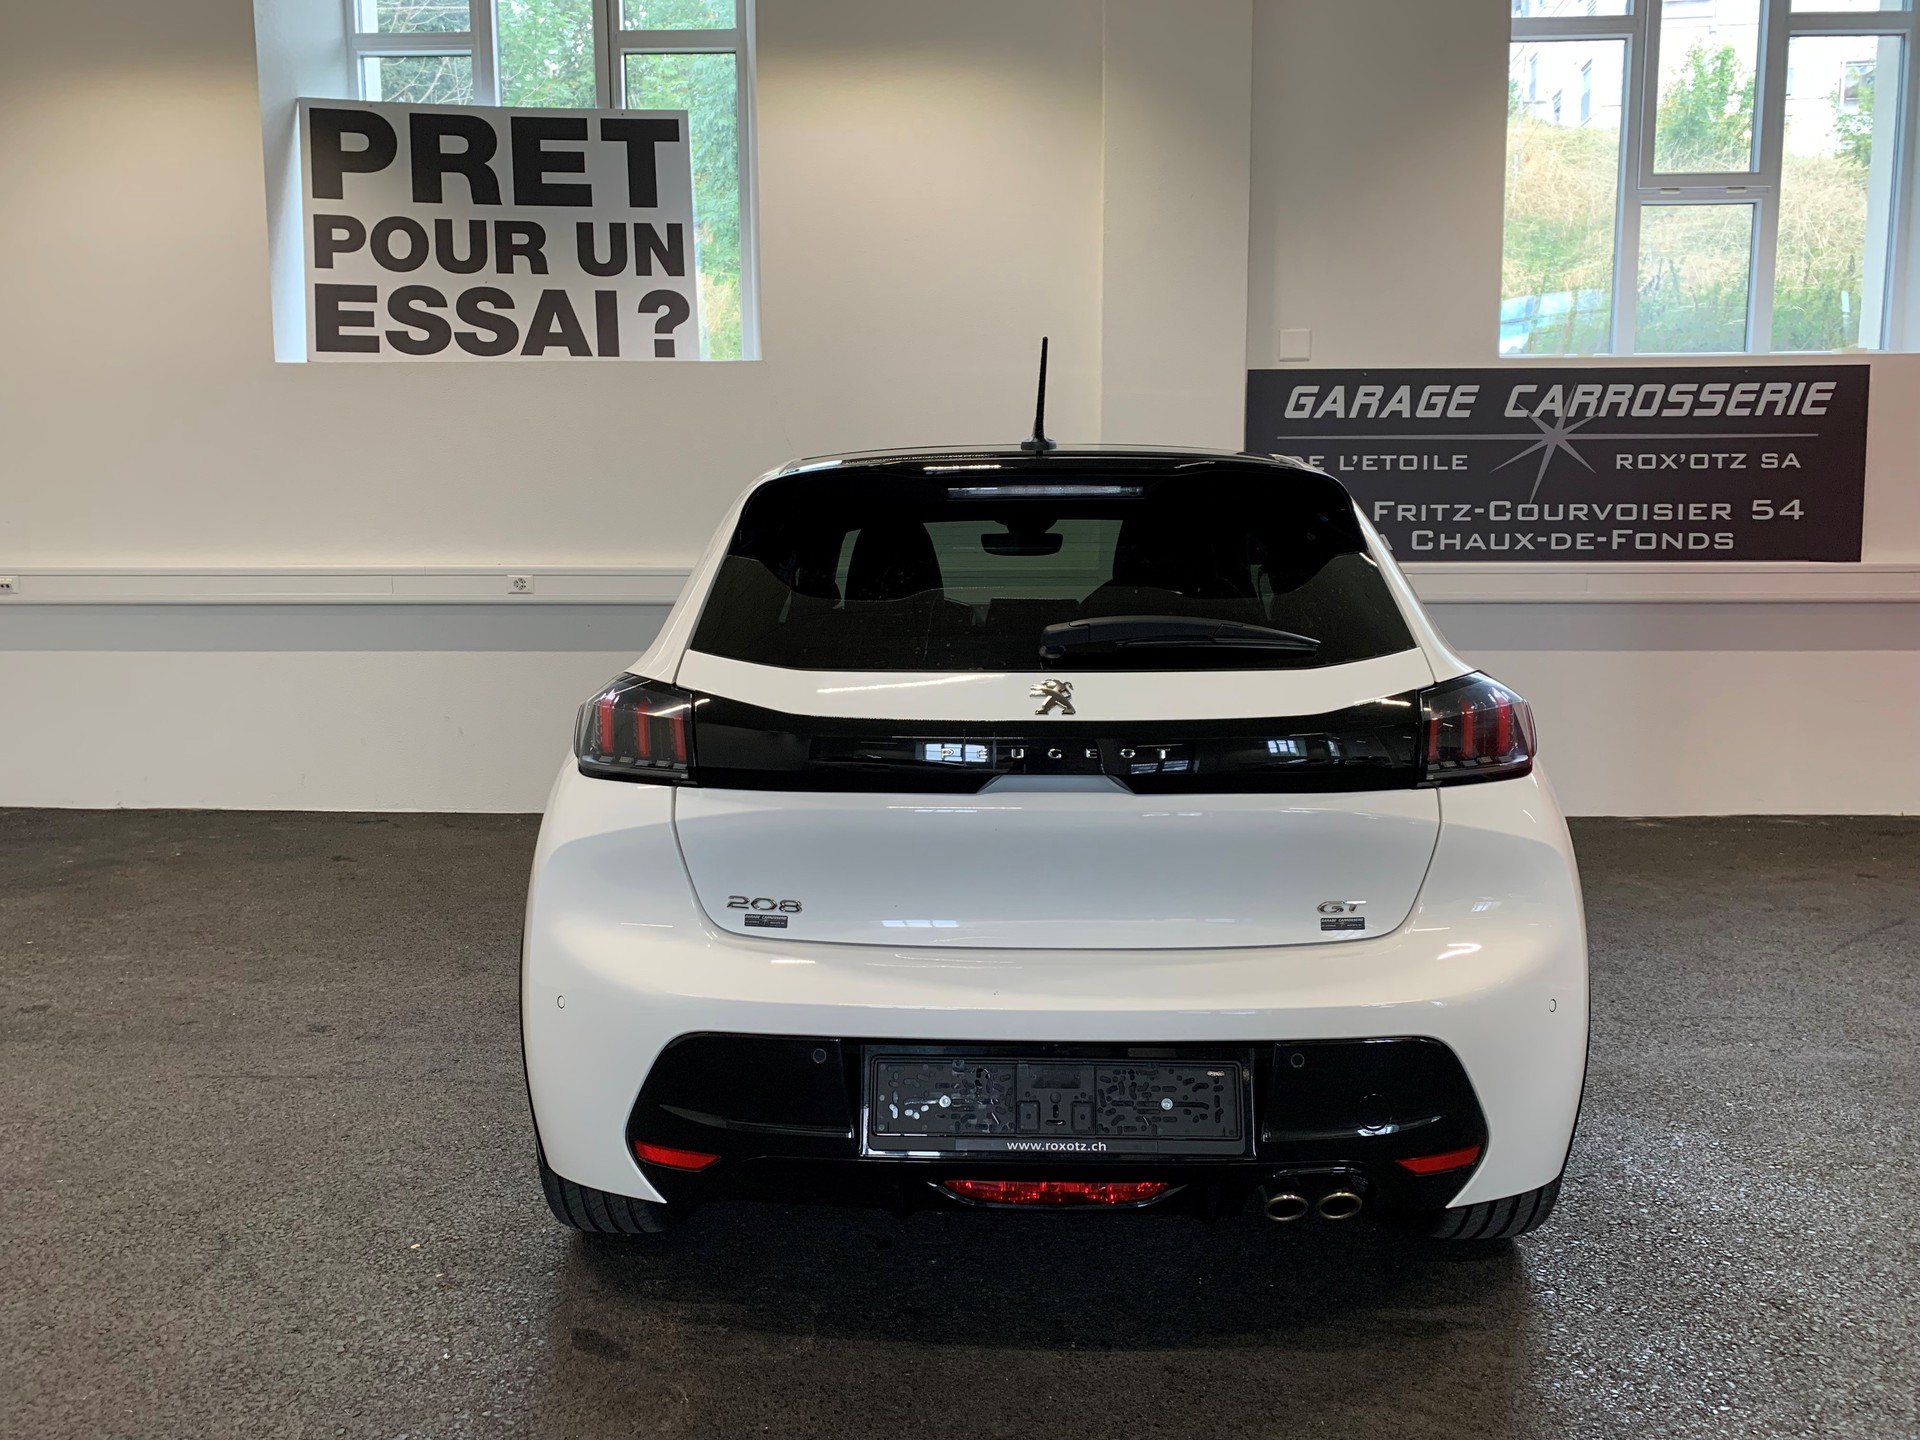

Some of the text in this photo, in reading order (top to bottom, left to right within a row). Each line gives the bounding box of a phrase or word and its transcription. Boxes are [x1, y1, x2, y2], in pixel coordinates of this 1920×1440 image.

[309, 107, 680, 208] PRET
[313, 213, 685, 277] POUR UN
[1284, 381, 1838, 419] GARAGE CARROSSERIE
[1761, 453, 1802, 470] SA
[1751, 499, 1805, 521] 54
[941, 747, 1171, 760] PEUGEOT
[727, 895, 803, 912] 208
[1317, 901, 1367, 914] GT
[1006, 1141, 1107, 1152] www.roxotz.ch
